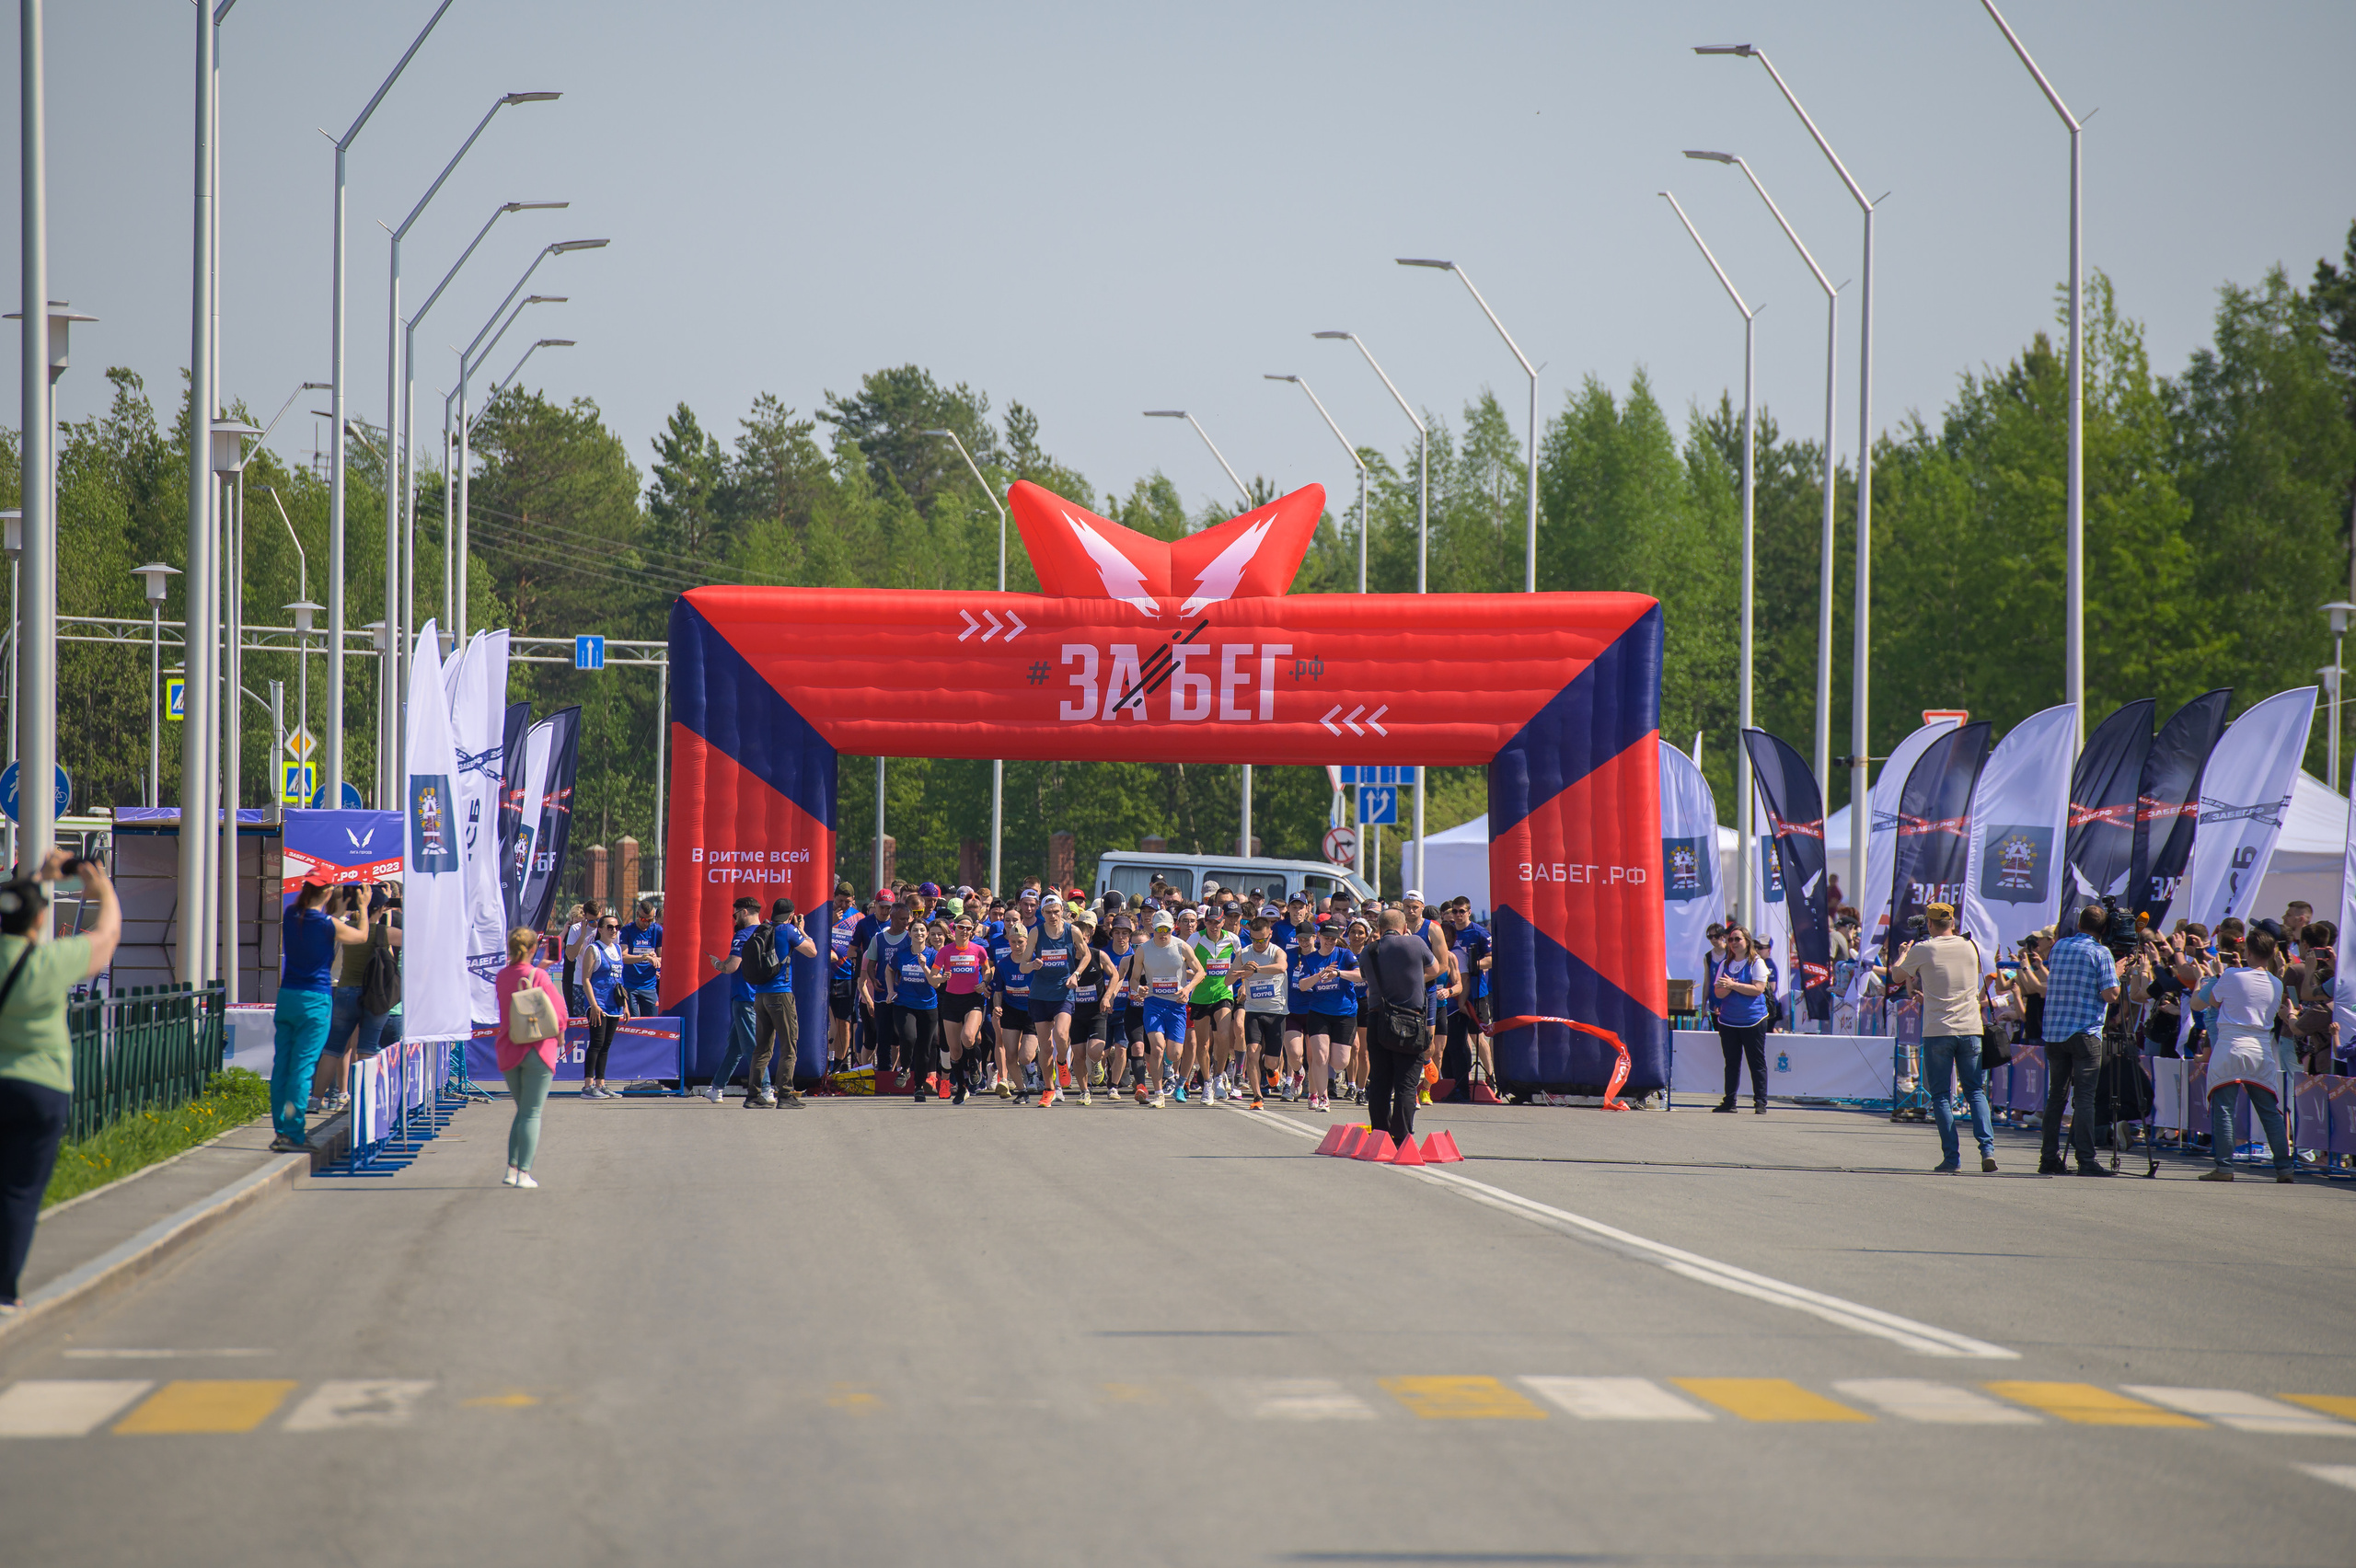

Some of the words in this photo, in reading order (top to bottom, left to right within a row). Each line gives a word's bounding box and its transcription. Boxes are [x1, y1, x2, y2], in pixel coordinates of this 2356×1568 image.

[2212, 807, 2265, 821] ЗАБЕГ.РФ
[1911, 821, 1956, 833] ЗАБЕГ.РФ
[288, 851, 316, 863] ЗАБЕГ.РФ
[692, 848, 704, 862] В
[709, 850, 765, 865] ритме
[769, 847, 810, 862] всей
[372, 861, 399, 875] 2023
[1519, 862, 1646, 885] ЗАБЕГ.РФ
[708, 869, 791, 883] СТРАНЫ!
